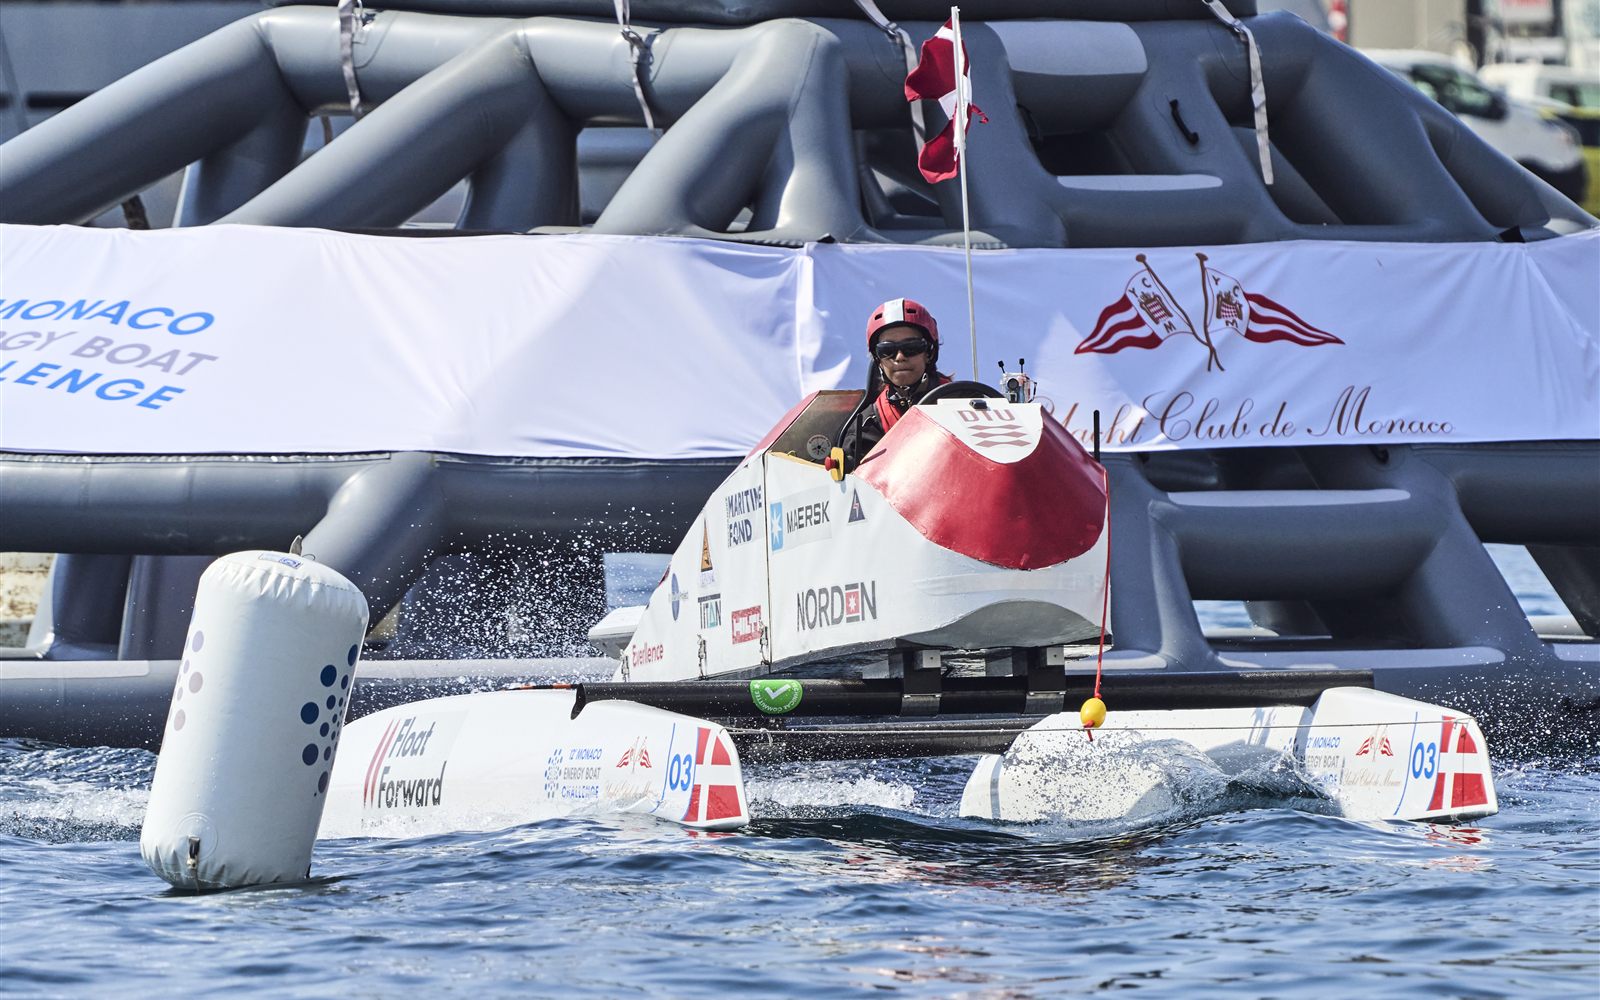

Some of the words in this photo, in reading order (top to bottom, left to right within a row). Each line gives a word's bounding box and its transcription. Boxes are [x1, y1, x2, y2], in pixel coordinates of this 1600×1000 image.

[0, 331, 78, 351] GY
[70, 336, 218, 376] BOAT
[957, 408, 1015, 422] DTU
[1034, 396, 1144, 444] Yaht
[1143, 391, 1254, 442] Club
[1259, 401, 1296, 438] de
[1306, 385, 1454, 438] Monaco
[729, 519, 752, 547] FOND
[786, 500, 830, 534] MAERSK
[388, 716, 436, 758] Float
[576, 748, 603, 760] MONACO
[1313, 736, 1341, 749] MONACO
[563, 767, 585, 780] ENERGY
[585, 767, 602, 780] BOAT
[669, 753, 693, 791] 03
[1323, 755, 1340, 768] BOAT
[1412, 741, 1436, 780] 03
[377, 760, 447, 808] Forward
